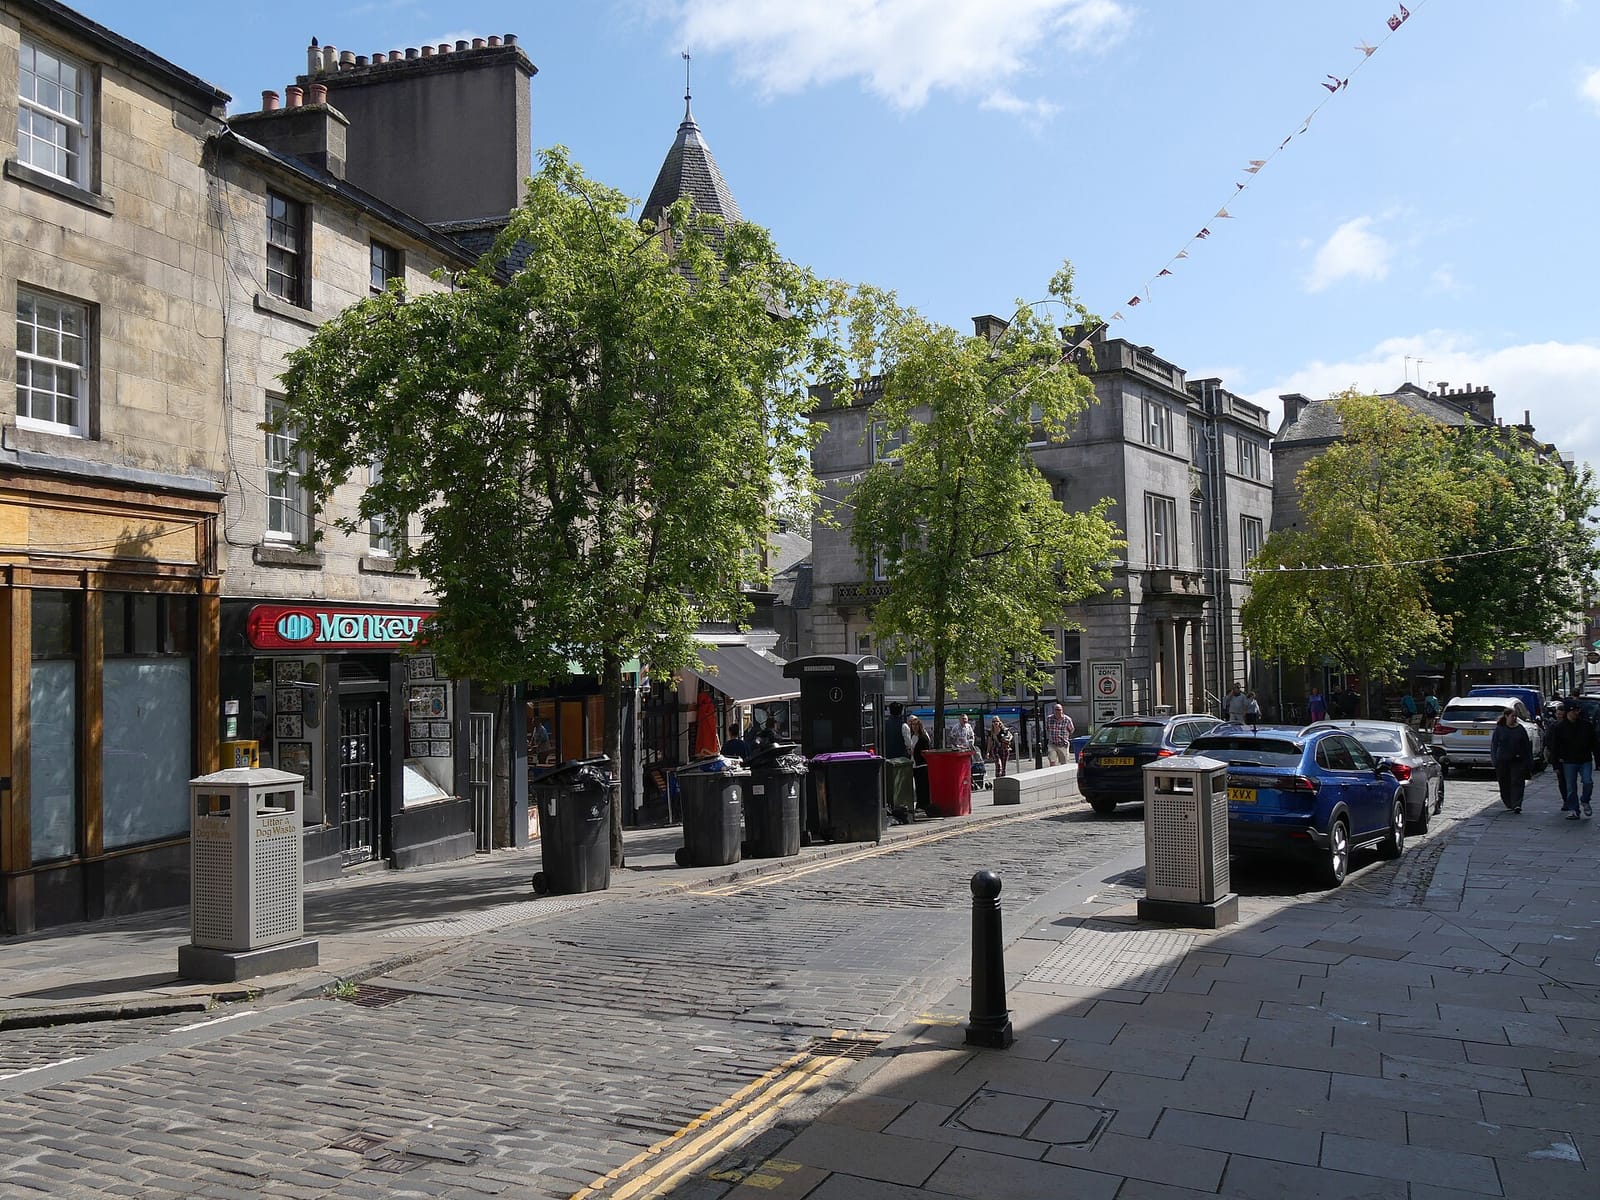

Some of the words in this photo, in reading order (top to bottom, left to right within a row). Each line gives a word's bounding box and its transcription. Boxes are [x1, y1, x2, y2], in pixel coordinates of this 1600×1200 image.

[278, 614, 313, 640] LAB
[1232, 790, 1252, 800] XVX
[262, 818, 283, 828] Litter
[256, 829, 272, 838] Dog
[272, 825, 296, 835] Waste
